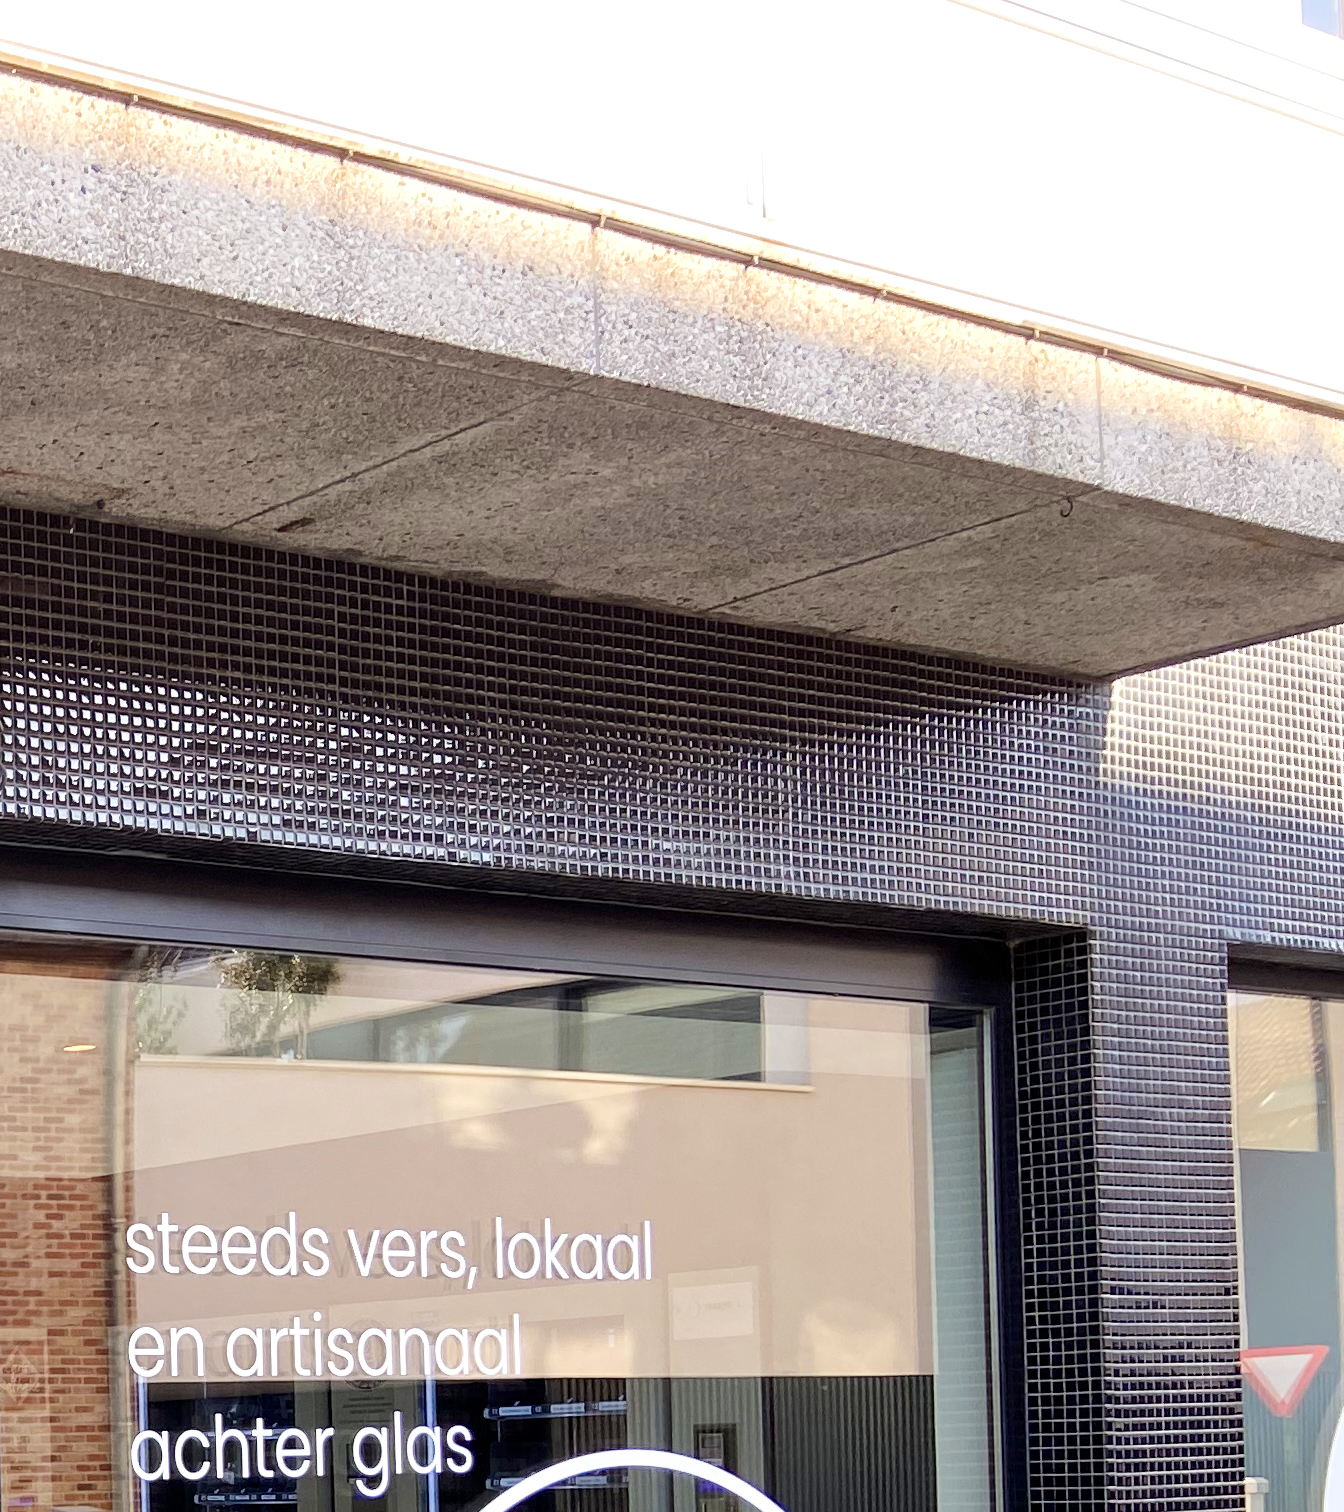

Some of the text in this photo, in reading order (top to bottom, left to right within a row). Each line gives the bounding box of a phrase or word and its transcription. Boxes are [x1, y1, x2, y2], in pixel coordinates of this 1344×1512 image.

[125, 1211, 653, 1290] steeds vers, lokaal
[128, 1311, 523, 1377] en artisanaal
[130, 1410, 474, 1497] achter glas
